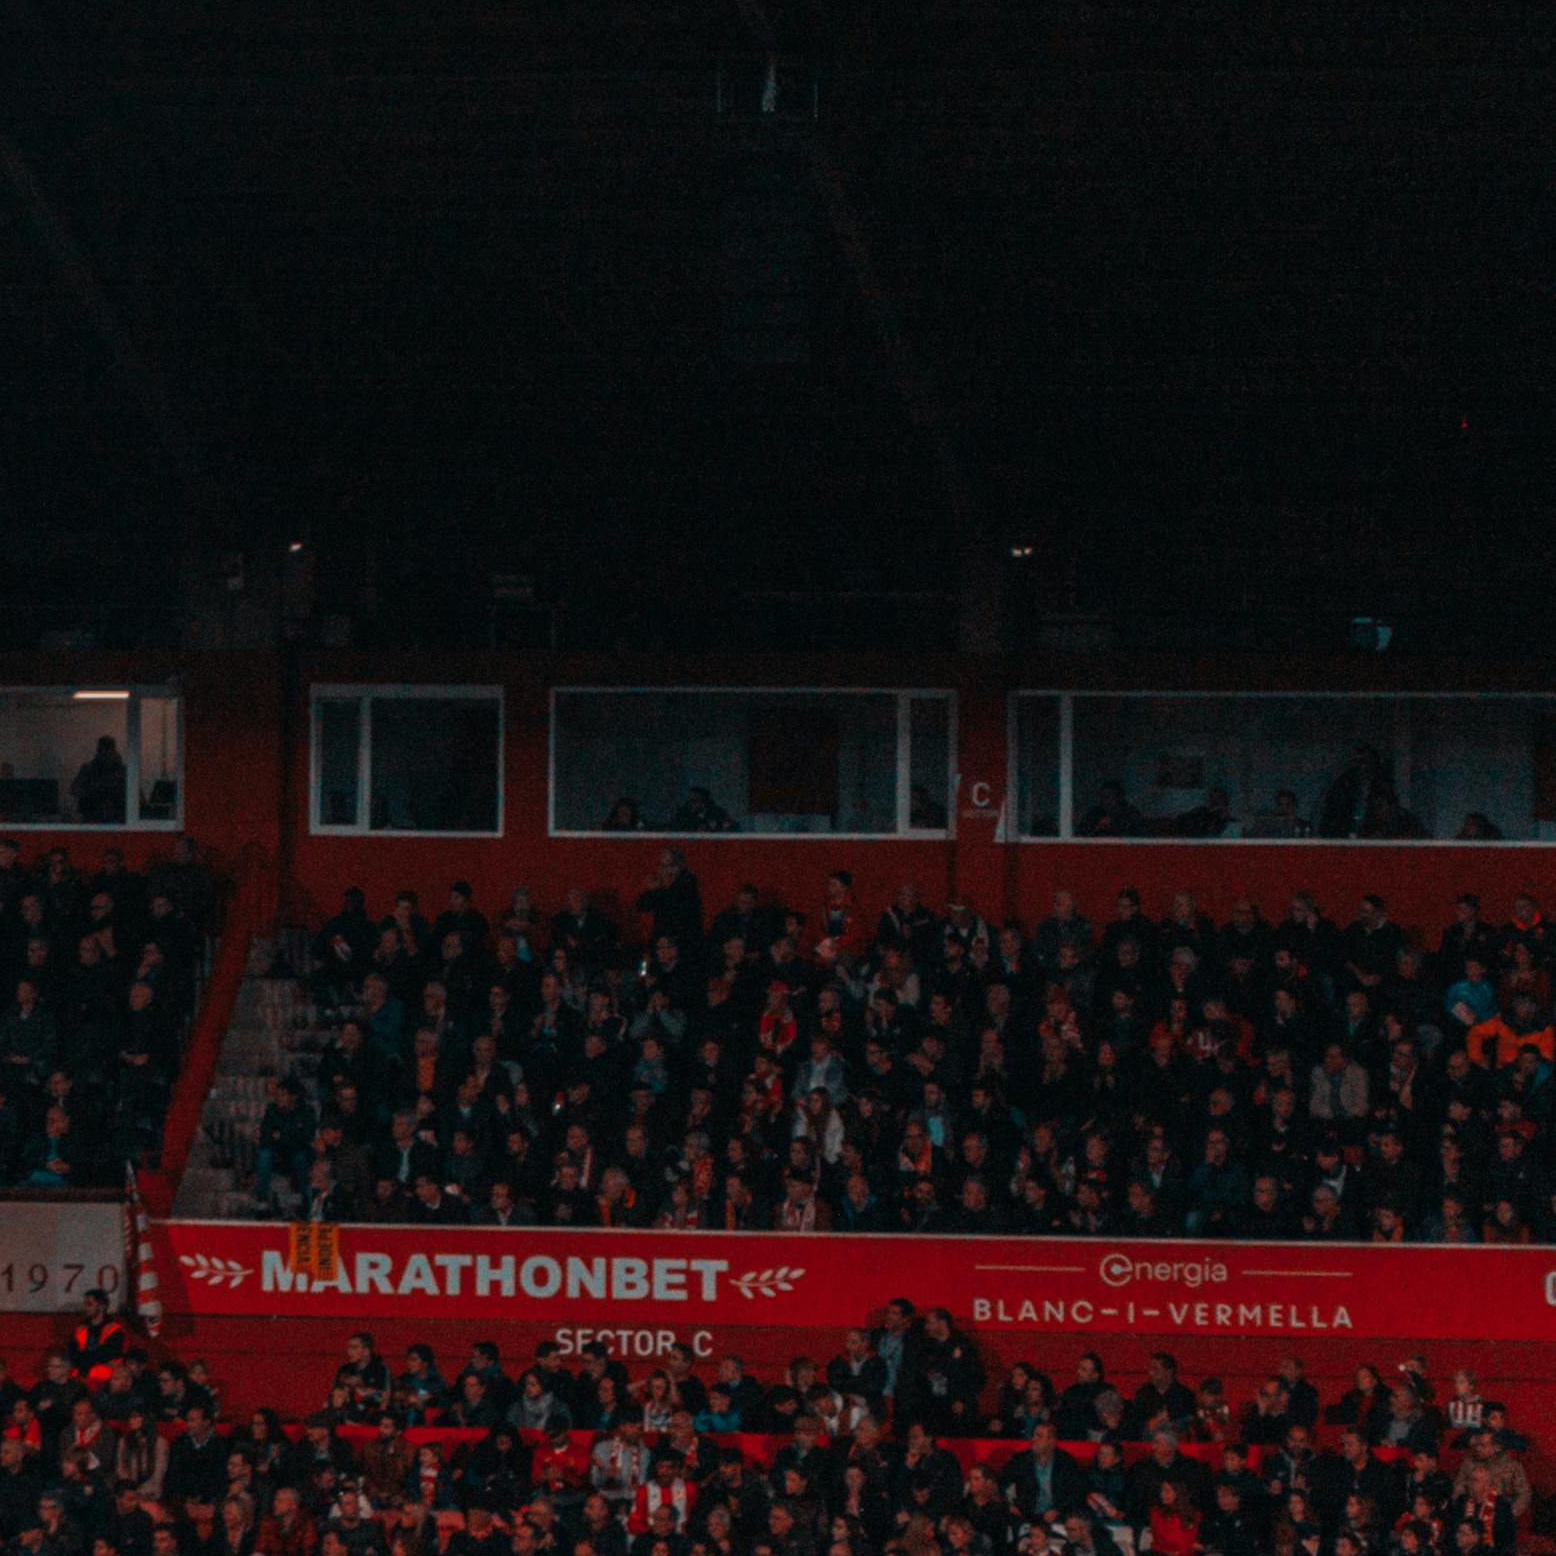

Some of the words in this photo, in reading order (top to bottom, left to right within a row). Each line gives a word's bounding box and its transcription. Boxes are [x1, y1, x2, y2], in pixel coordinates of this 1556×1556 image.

[0, 1263, 119, 1294] 1970
[261, 1249, 730, 1302] MARATHONBET
[693, 1330, 713, 1358] C
